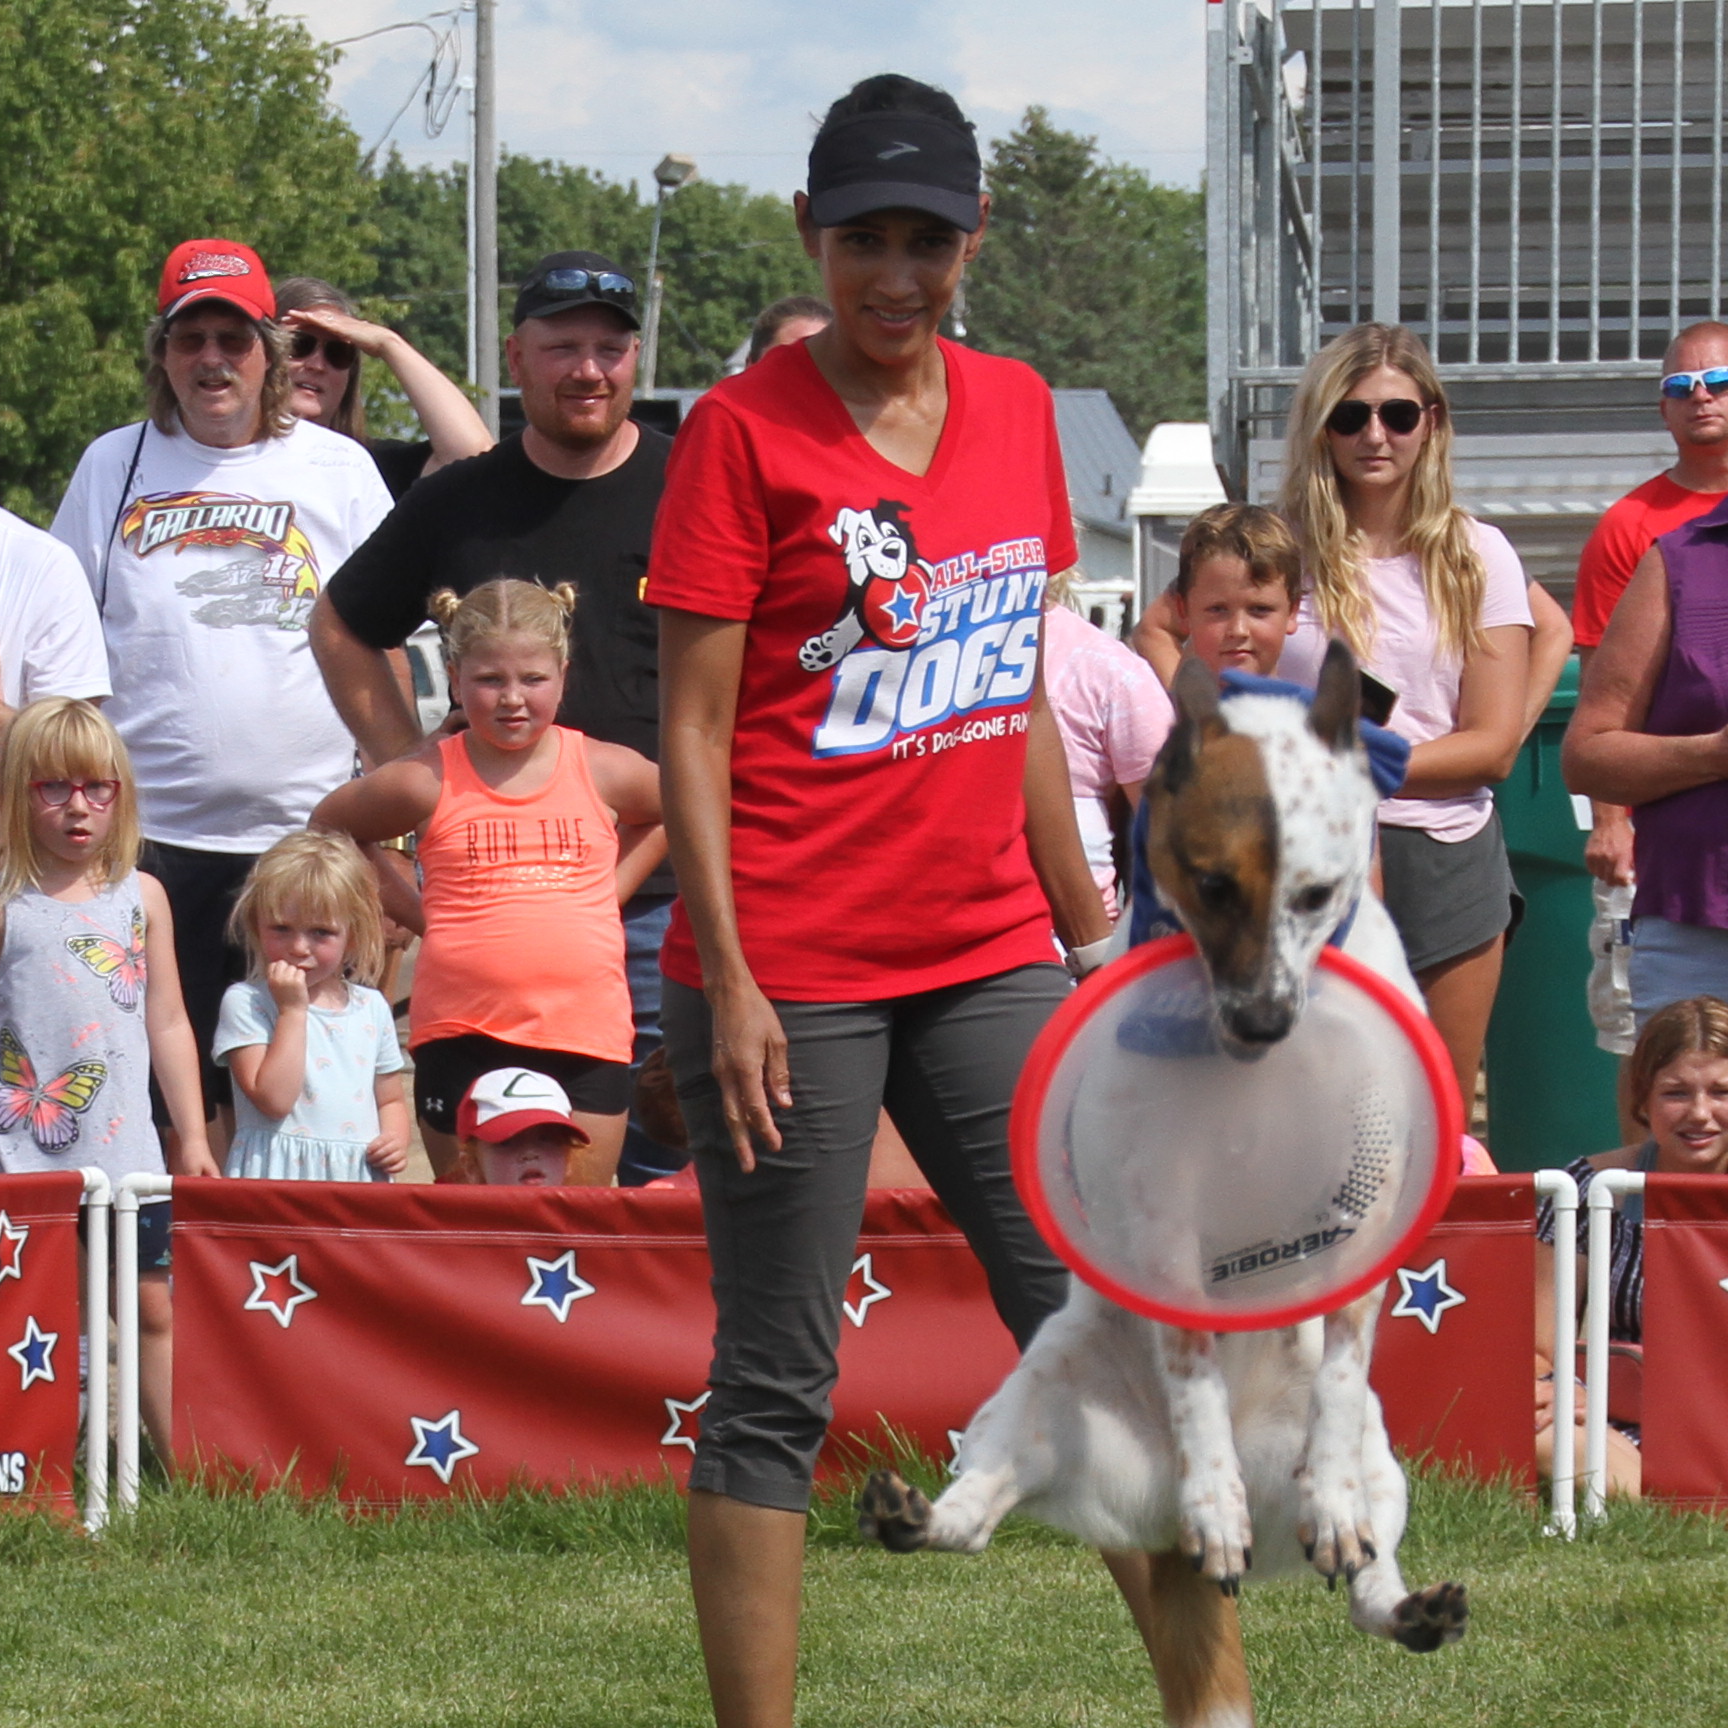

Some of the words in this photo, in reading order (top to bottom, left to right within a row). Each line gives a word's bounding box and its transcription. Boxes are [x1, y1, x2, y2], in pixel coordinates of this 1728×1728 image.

[138, 503, 290, 556] GALLARDO
[263, 554, 305, 580] 17
[930, 537, 1045, 594] ALL-STAR
[917, 572, 1048, 646] STUNT
[815, 615, 1041, 751] DOGS
[892, 733, 926, 760] IT'S
[467, 821, 517, 865] RUN
[537, 817, 587, 861] THE
